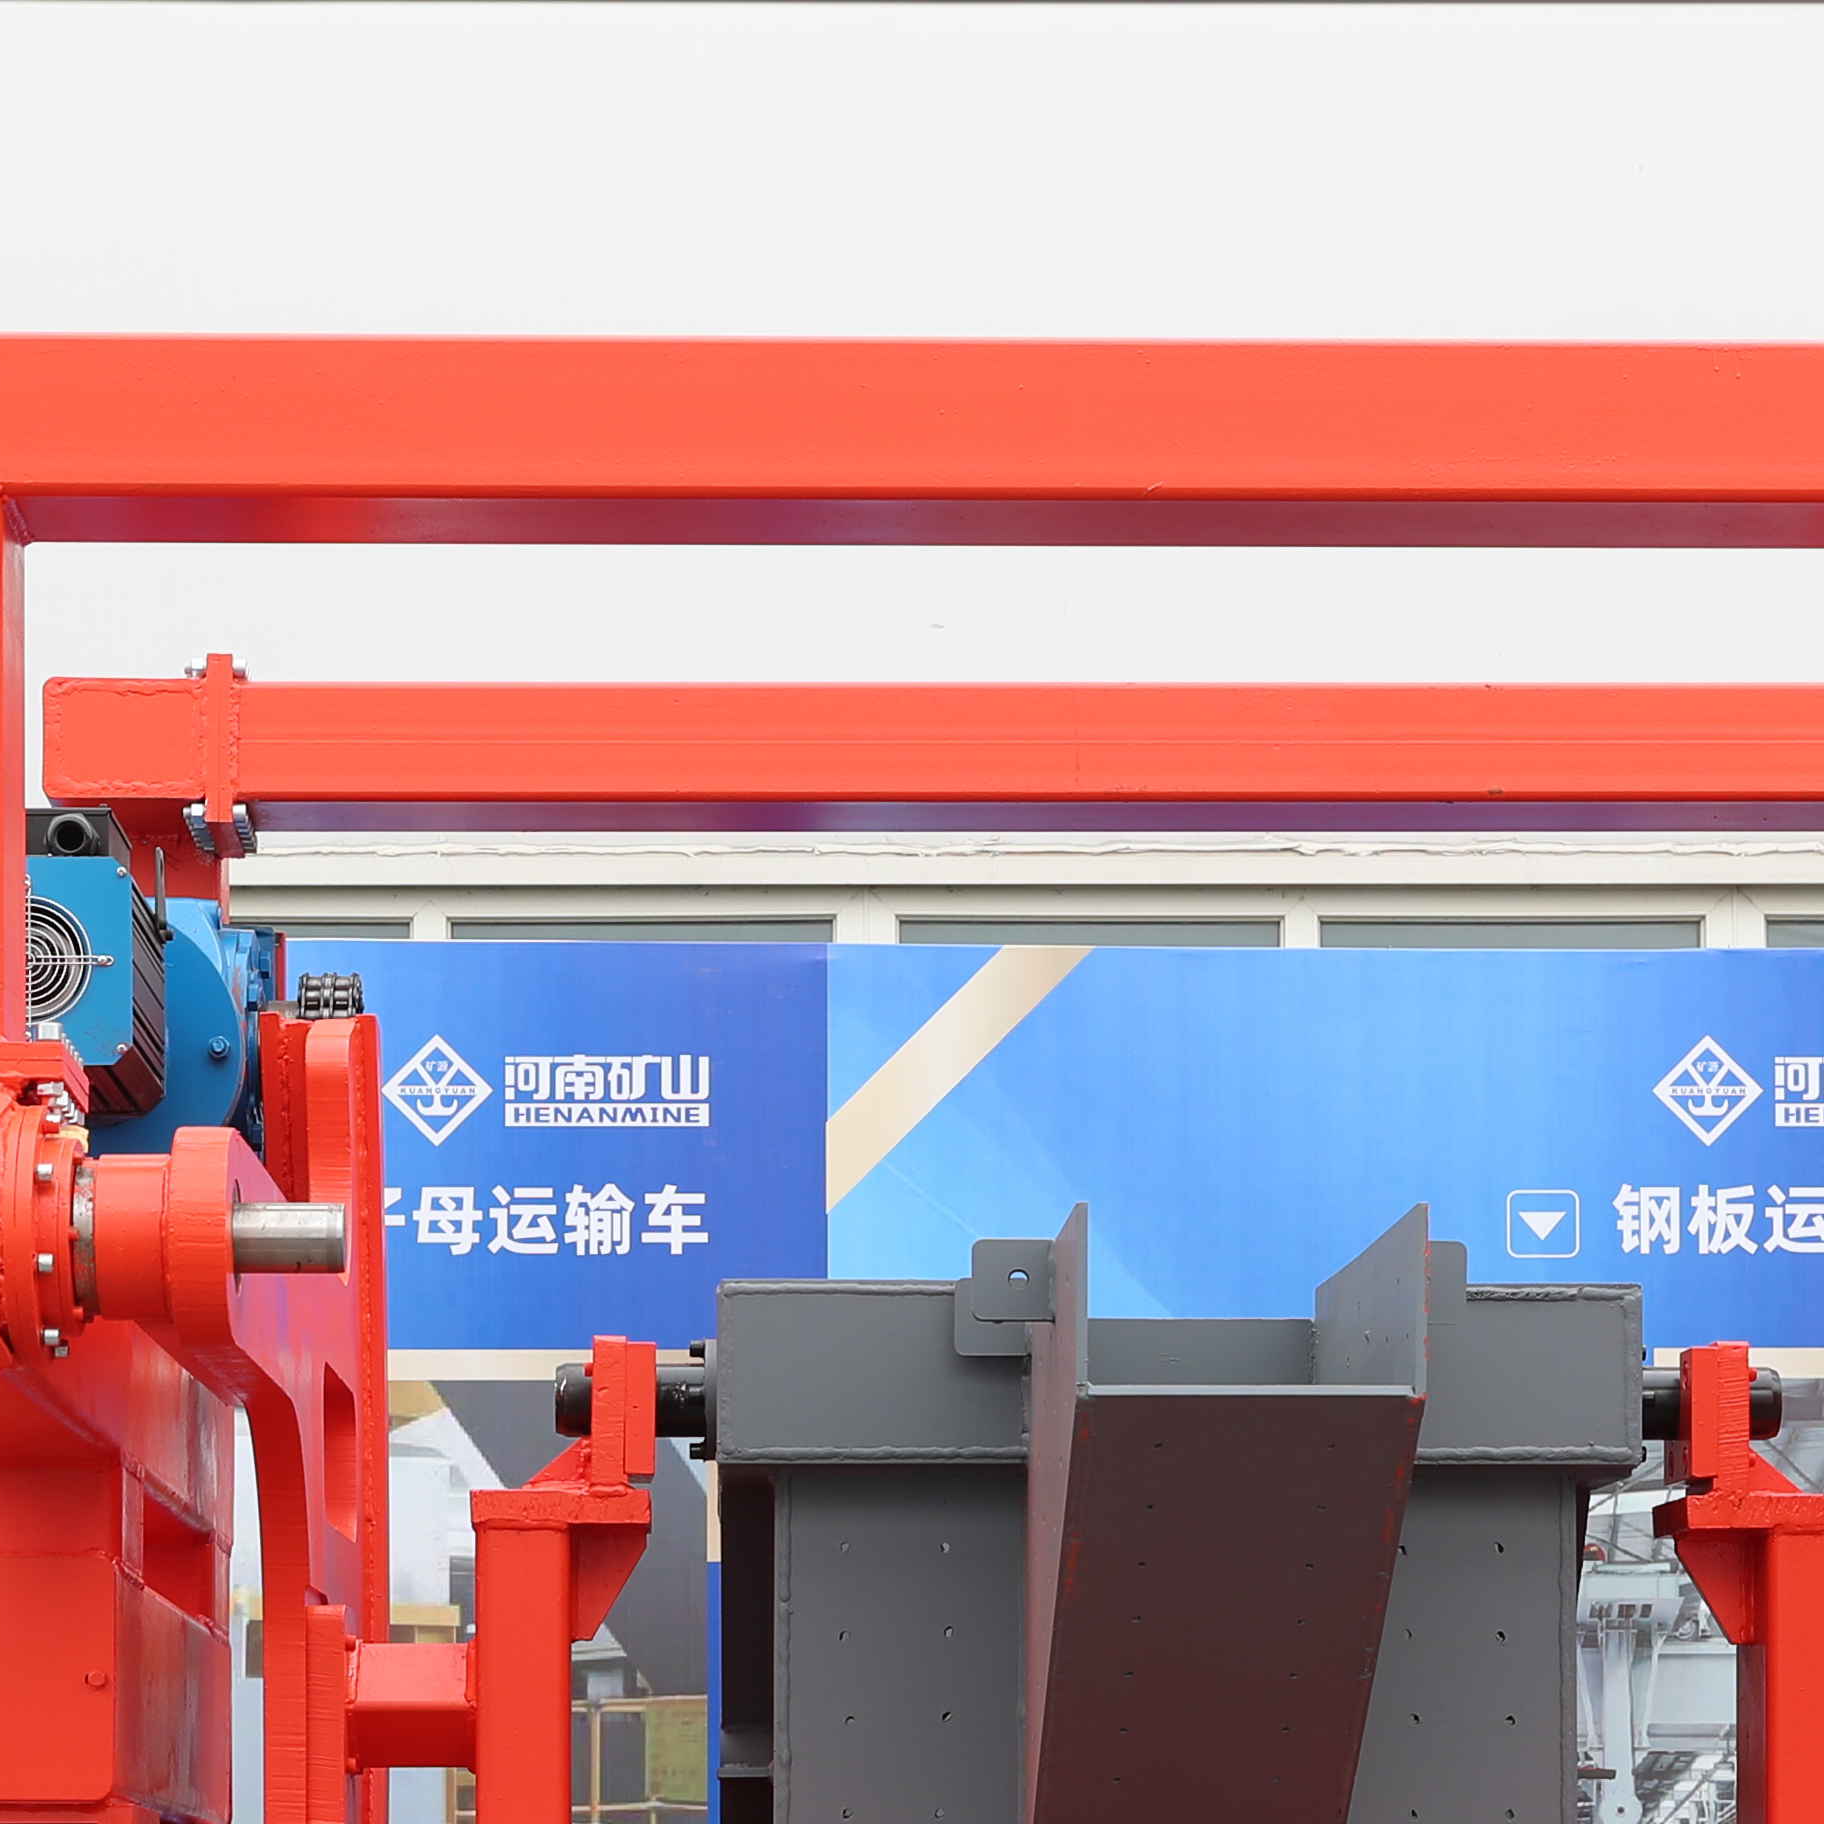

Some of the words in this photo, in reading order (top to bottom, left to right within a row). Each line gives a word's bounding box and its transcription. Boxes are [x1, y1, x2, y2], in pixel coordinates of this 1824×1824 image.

[505, 1054, 710, 1101] 河南矿山
[400, 1087, 476, 1095] KUANGYUAN
[1672, 1087, 1746, 1095] KUANGYUAN
[513, 1107, 701, 1123] HENANMINE
